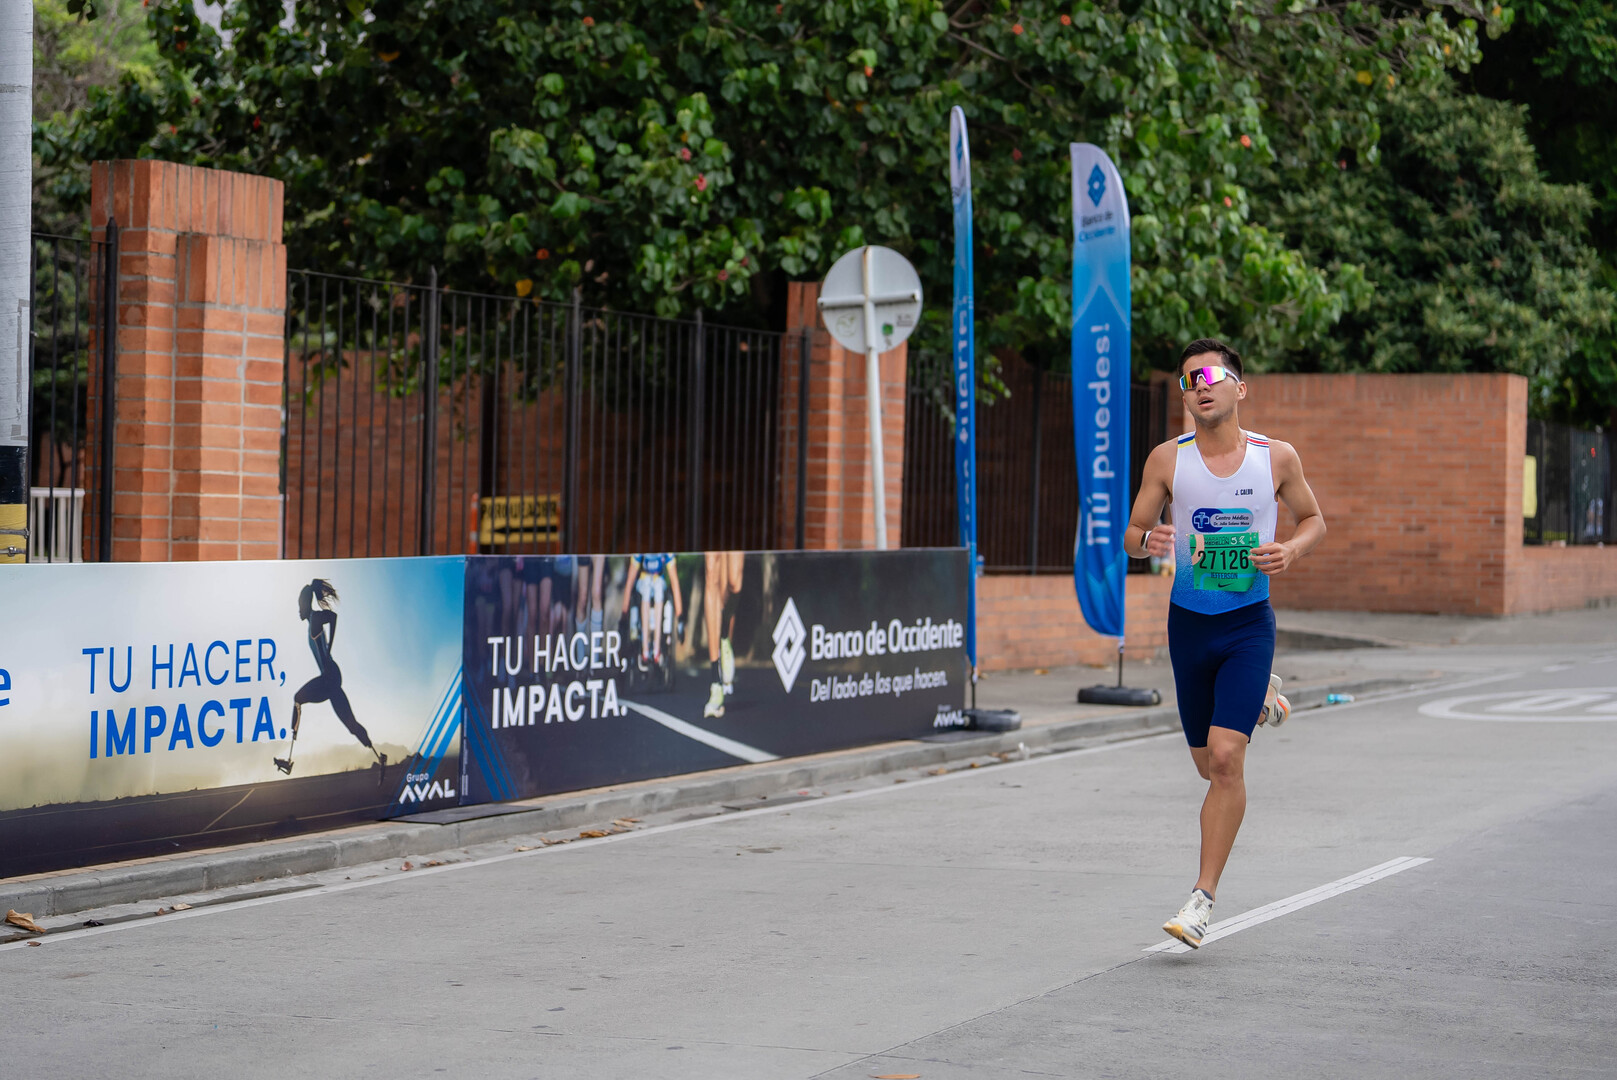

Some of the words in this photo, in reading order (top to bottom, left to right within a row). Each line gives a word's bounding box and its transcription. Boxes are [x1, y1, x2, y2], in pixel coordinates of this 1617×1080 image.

[1088, 322, 1115, 479] puedes!
[1197, 549, 1249, 570] 27126
[487, 634, 523, 676] TU
[534, 630, 628, 674] HACER,
[811, 624, 864, 661] Banco
[865, 620, 887, 656] de
[888, 617, 964, 654] Occidente
[82, 646, 133, 694] TU
[151, 638, 287, 690] HACER,
[810, 676, 831, 702] Del
[832, 673, 858, 699] lado
[858, 672, 874, 696] de
[875, 671, 891, 694] los
[892, 674, 914, 698] que
[491, 679, 628, 730] IMPACTA.
[89, 696, 287, 759] IMPACTA.
[399, 779, 456, 804] AVAL
[406, 772, 430, 783] Grupo
